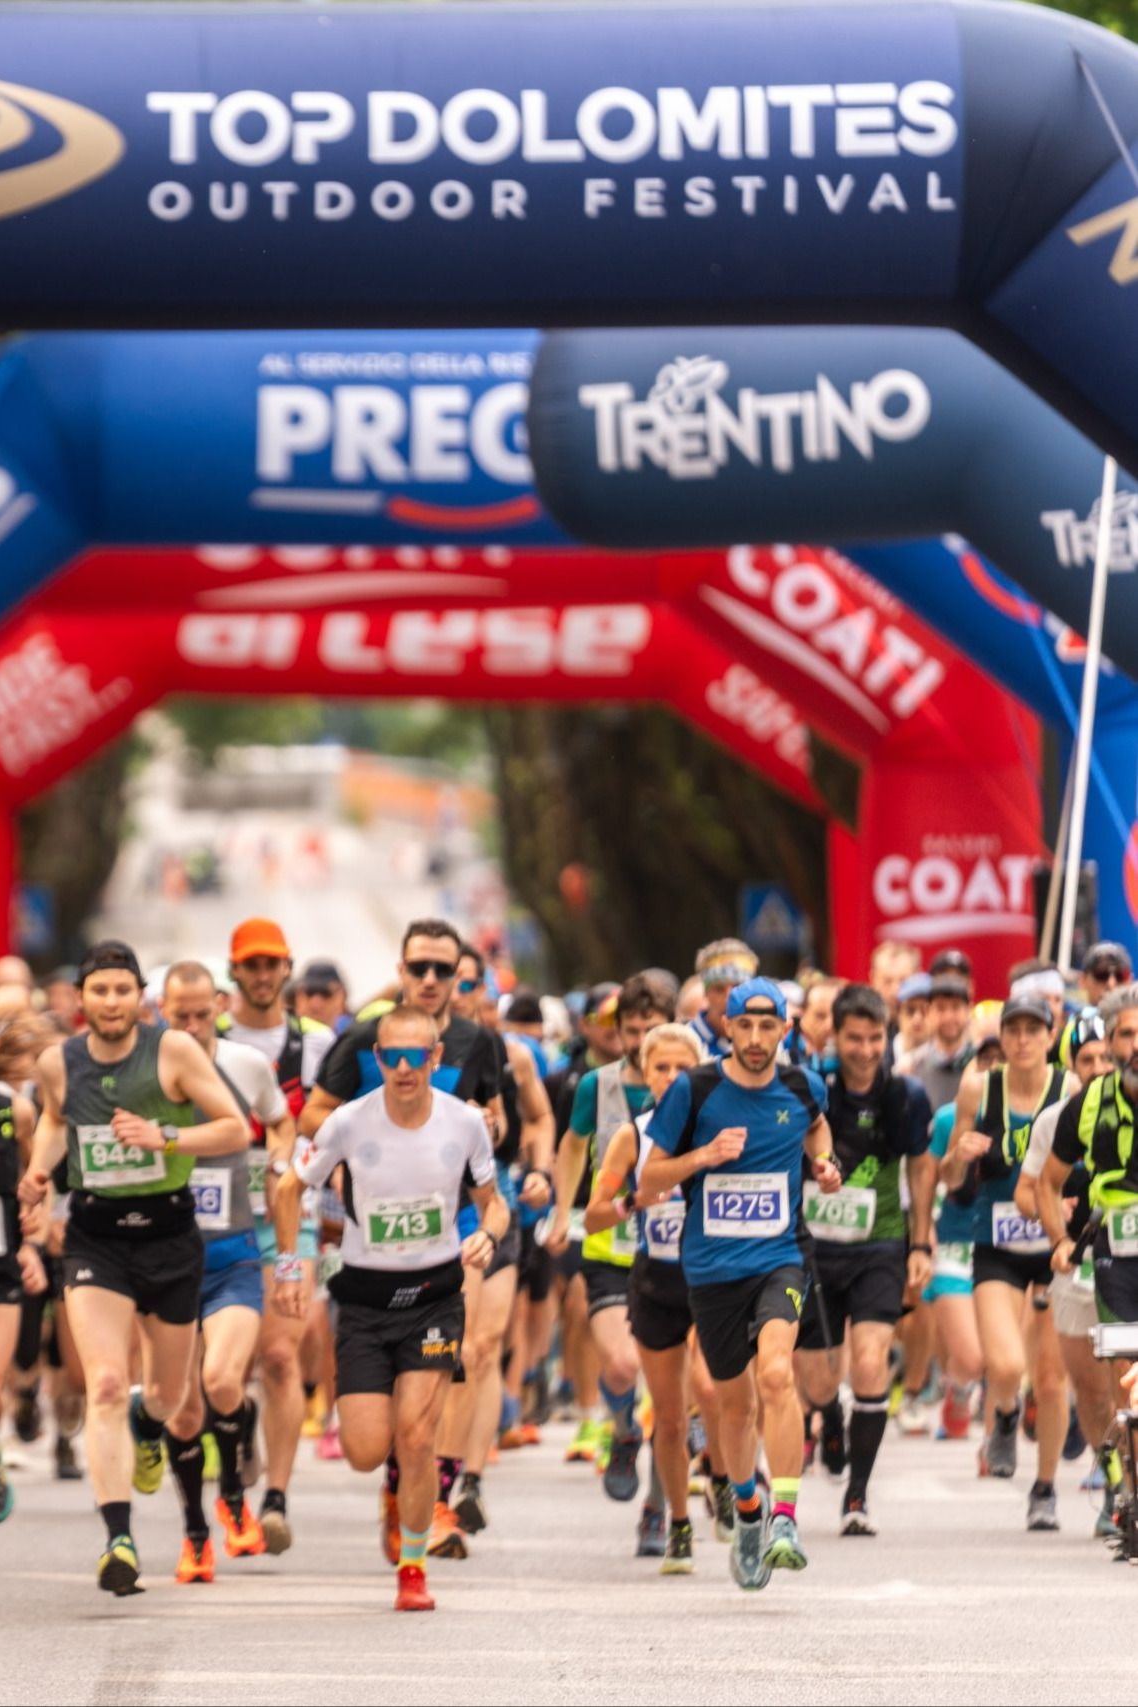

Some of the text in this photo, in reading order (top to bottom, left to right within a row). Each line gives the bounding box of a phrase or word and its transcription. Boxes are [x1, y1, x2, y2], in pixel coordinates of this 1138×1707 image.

[145, 80, 958, 166] TOP DOLOMITES
[147, 171, 956, 222] OUTDOOR FESTIVAL
[578, 366, 932, 479] TRENTINO
[380, 1211, 430, 1239] 713
[713, 1193, 775, 1218] 1275
